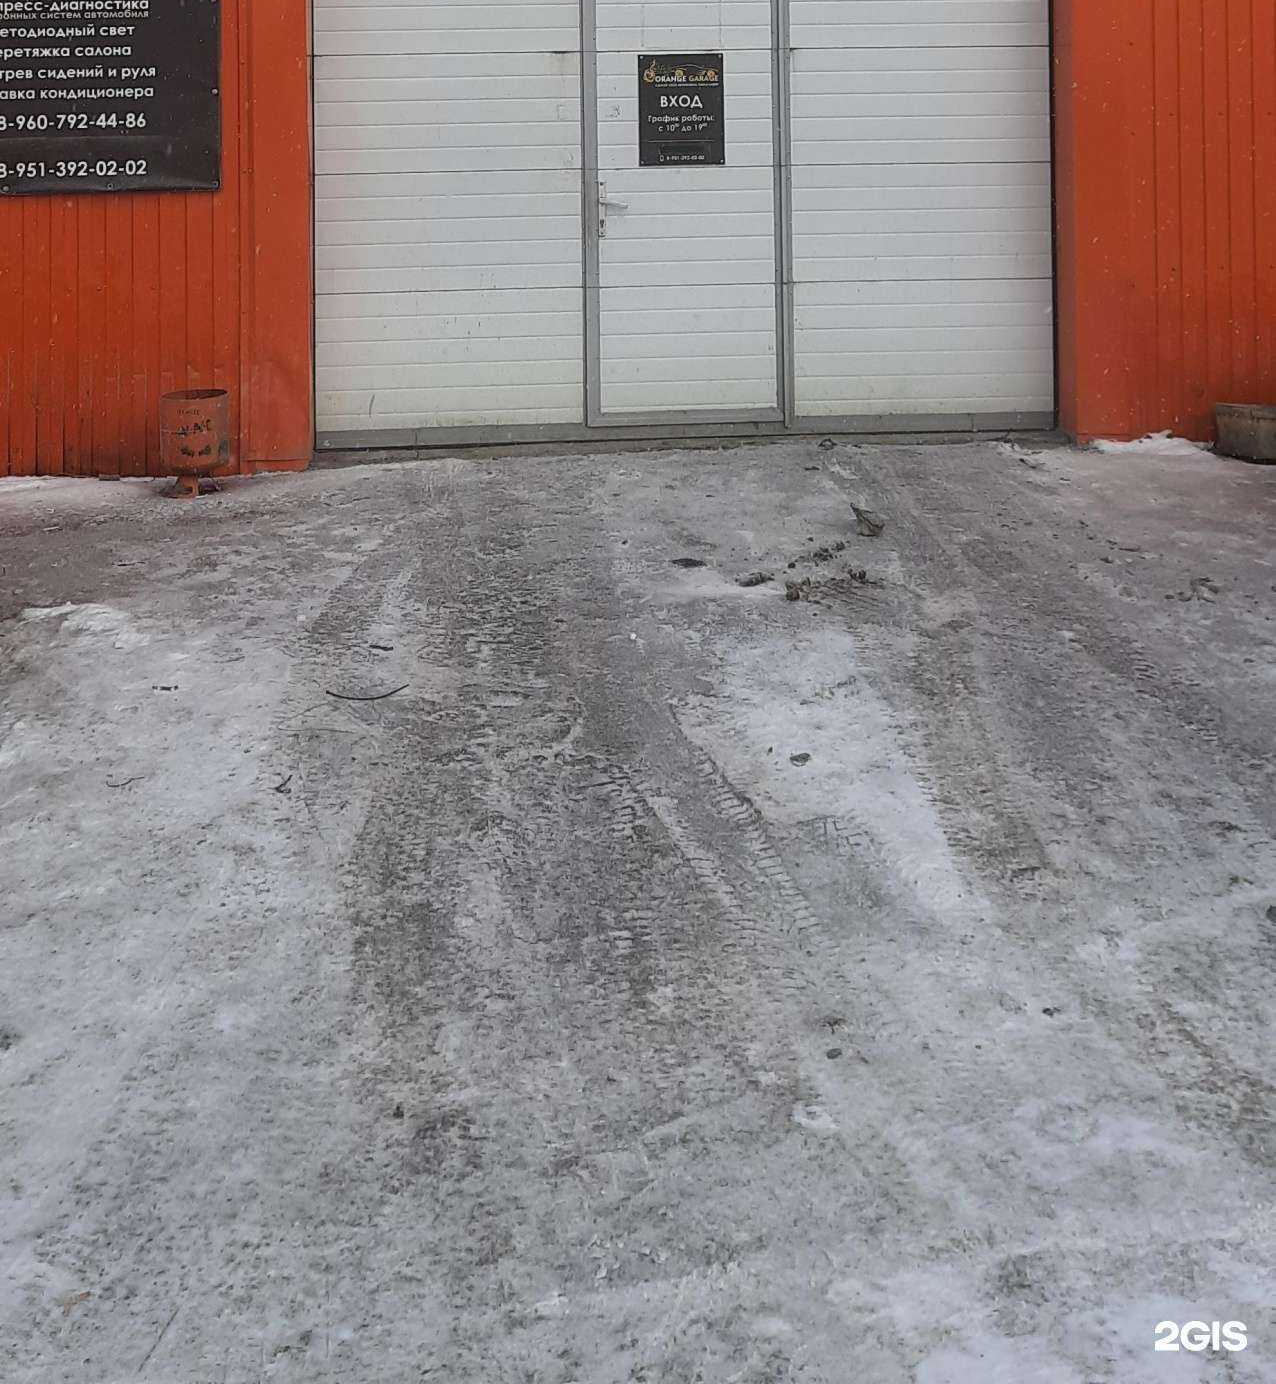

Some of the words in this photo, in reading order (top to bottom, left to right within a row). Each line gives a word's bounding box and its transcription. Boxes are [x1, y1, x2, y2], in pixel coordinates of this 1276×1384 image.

[40, 11, 82, 19] систем
[84, 9, 149, 19] автомобиля
[99, 26, 135, 36] свет
[75, 46, 132, 57] салона
[38, 65, 103, 79] сидений
[108, 69, 117, 78] и
[121, 67, 156, 80] руля
[40, 87, 154, 100] кондиционера
[660, 95, 703, 109] ВХОД
[0, 113, 147, 131] 8-960-792-44-86
[0, 160, 147, 178] 8-951-392-02-02
